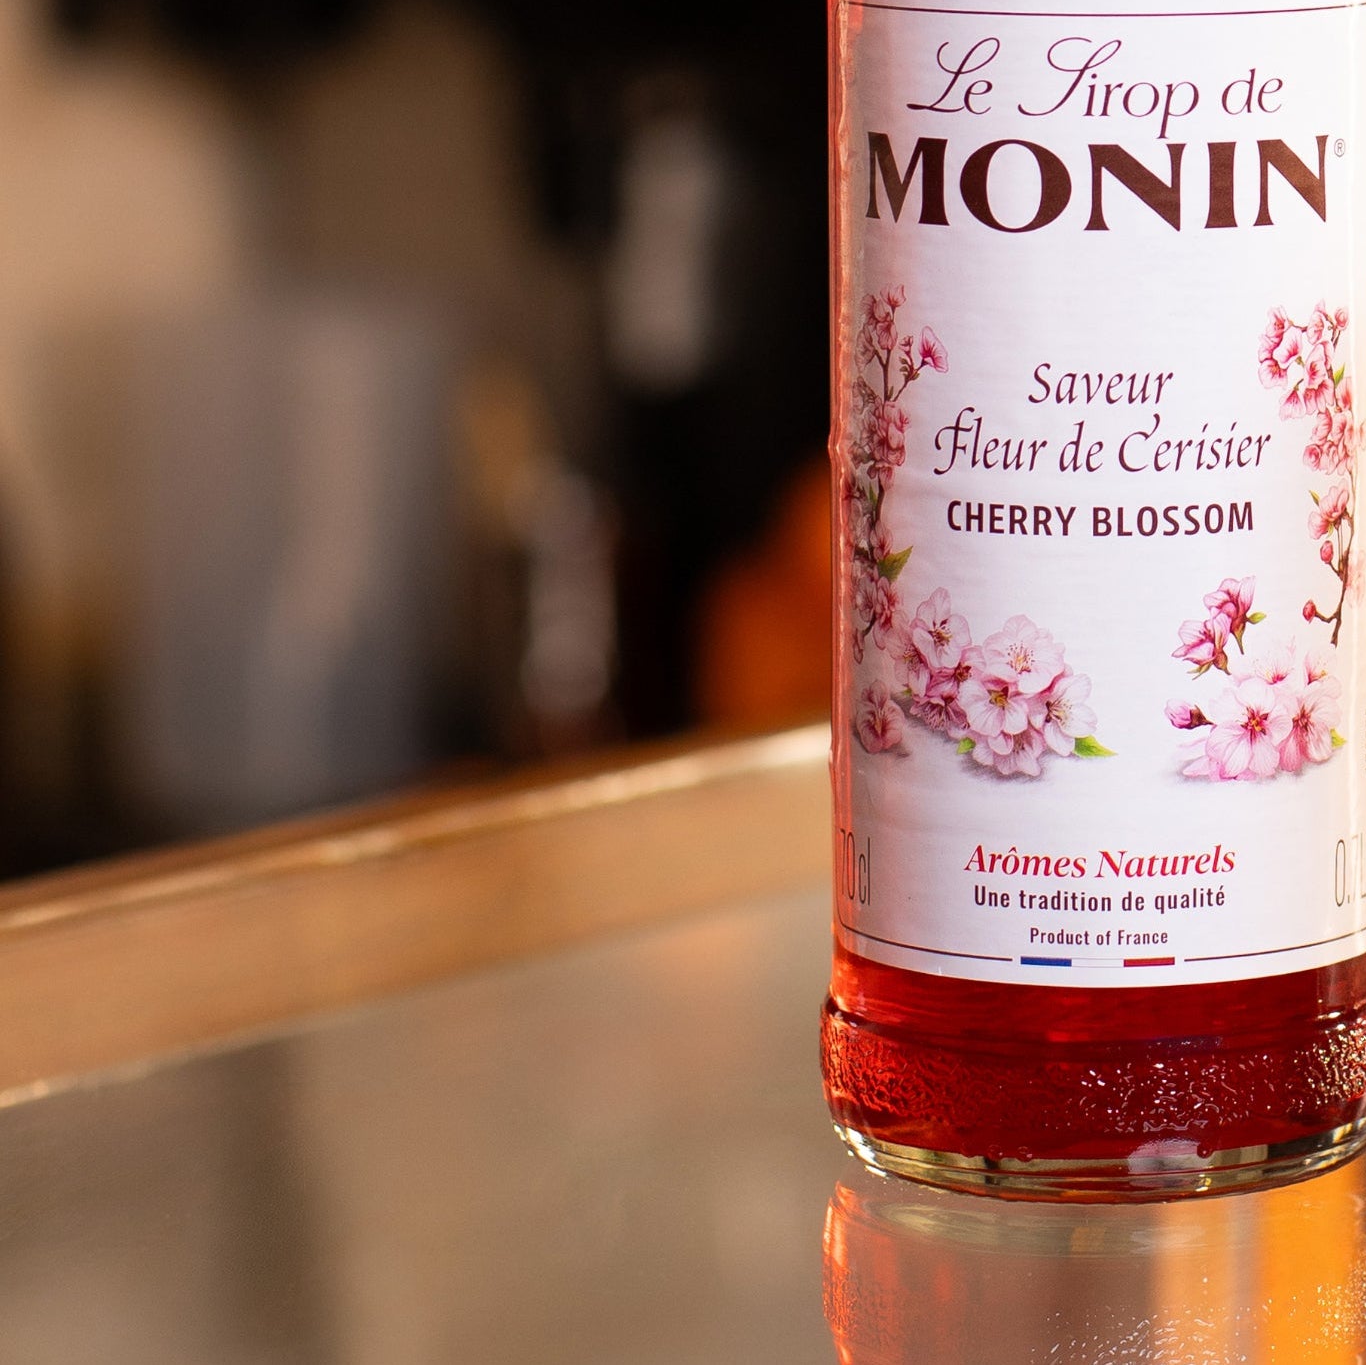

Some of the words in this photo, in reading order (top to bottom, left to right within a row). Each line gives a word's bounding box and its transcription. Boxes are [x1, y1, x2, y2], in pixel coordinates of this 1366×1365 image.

[906, 37, 1000, 115] Le
[1017, 37, 1200, 139] Sirop
[1221, 68, 1283, 115] de
[1028, 363, 1174, 405] Saveur
[934, 407, 1048, 475] Fleur
[1059, 420, 1104, 472] de
[1118, 413, 1271, 472] Cerisier
[947, 500, 1077, 536] CHERRY
[1093, 501, 1253, 537] BLOSSOM
[964, 845, 1086, 878] Arômes
[1094, 844, 1235, 878] Naturels
[975, 885, 1010, 908] Une
[1019, 890, 1111, 912] tradition
[1122, 891, 1144, 911] de
[1155, 885, 1225, 914] qualité
[1030, 927, 1090, 945] Product
[1096, 930, 1111, 946] of
[1118, 930, 1168, 945] France
